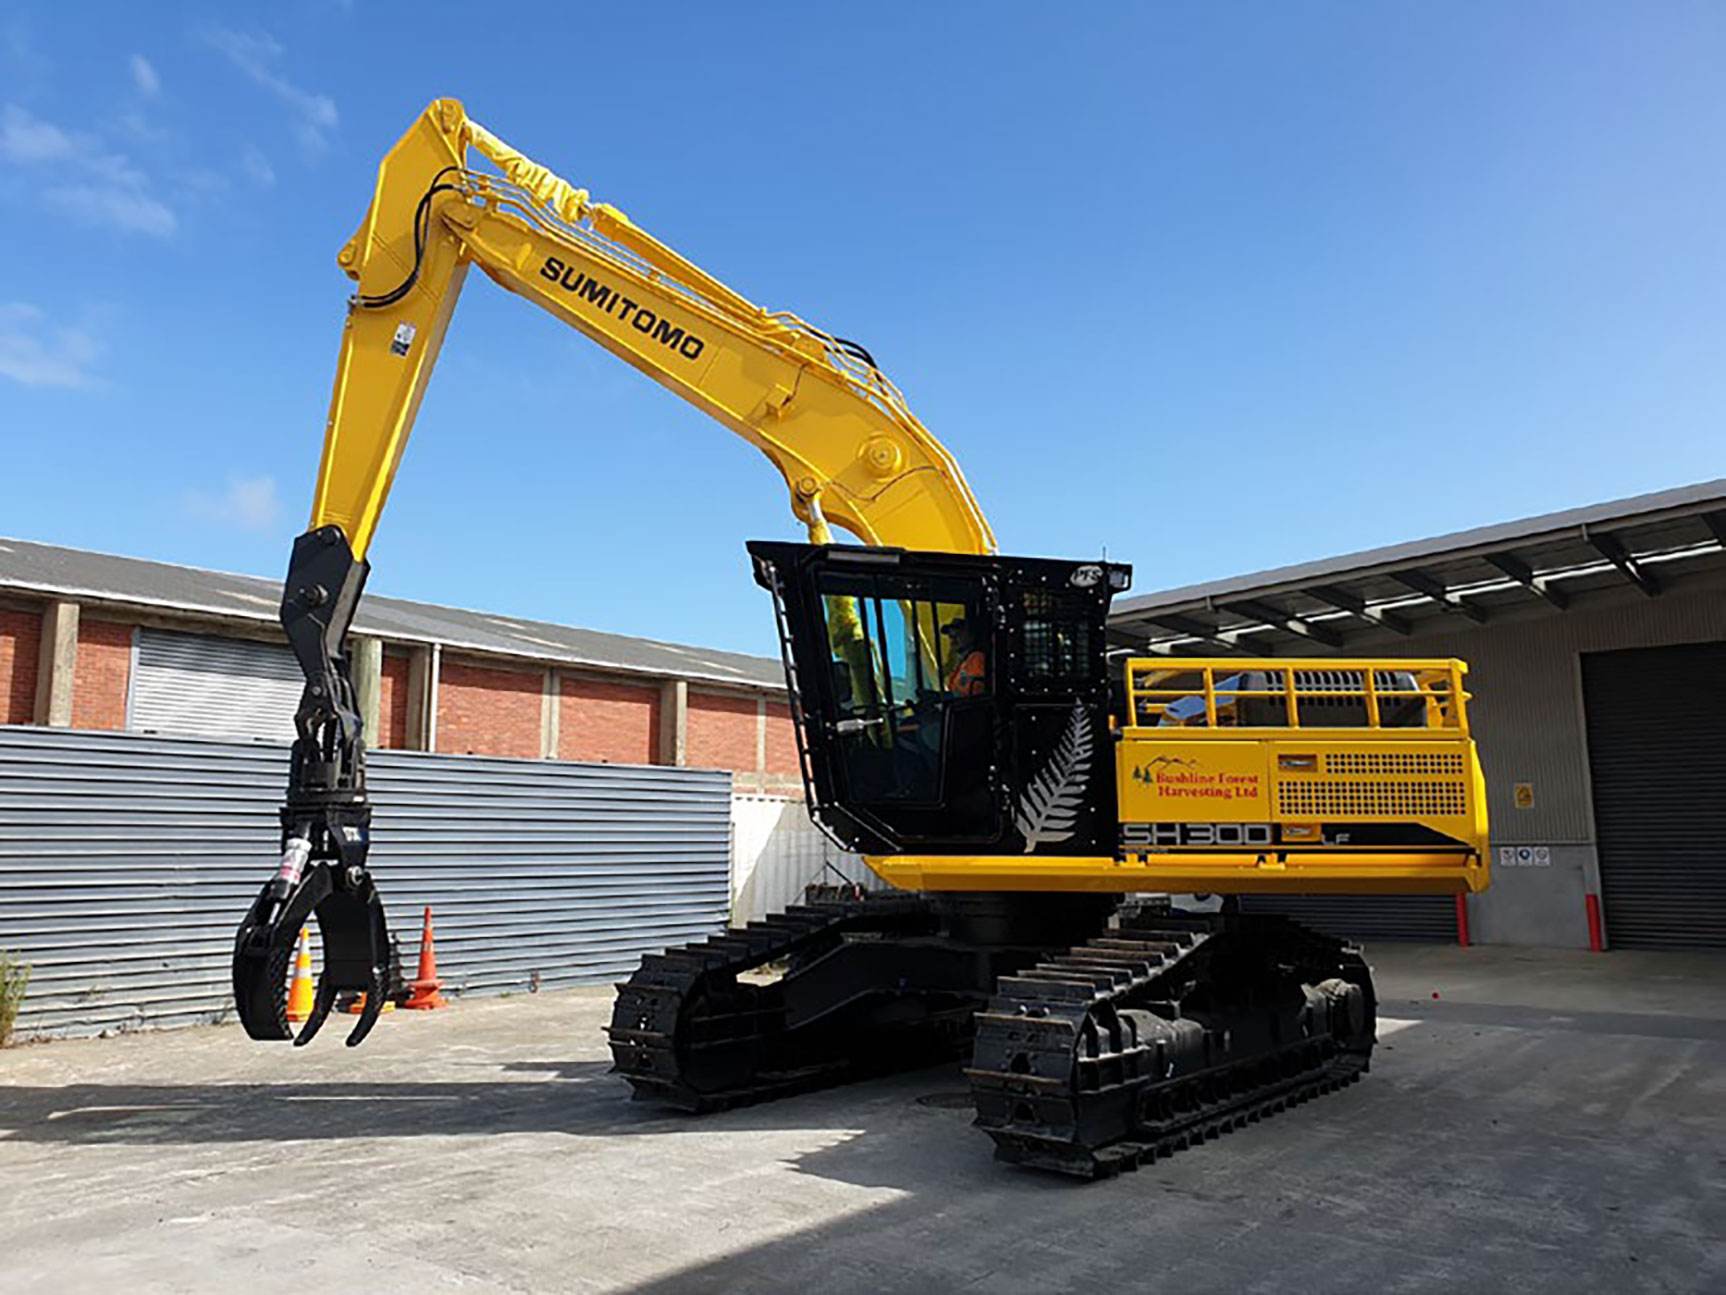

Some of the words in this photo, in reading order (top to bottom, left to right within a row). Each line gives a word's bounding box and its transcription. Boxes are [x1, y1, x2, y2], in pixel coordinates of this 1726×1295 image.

[540, 257, 705, 360] SUMITOMO
[1157, 770, 1215, 783] Bushline
[1219, 771, 1258, 783] Forest
[1158, 785, 1233, 799] Harvesting
[1235, 786, 1257, 797] Ltd
